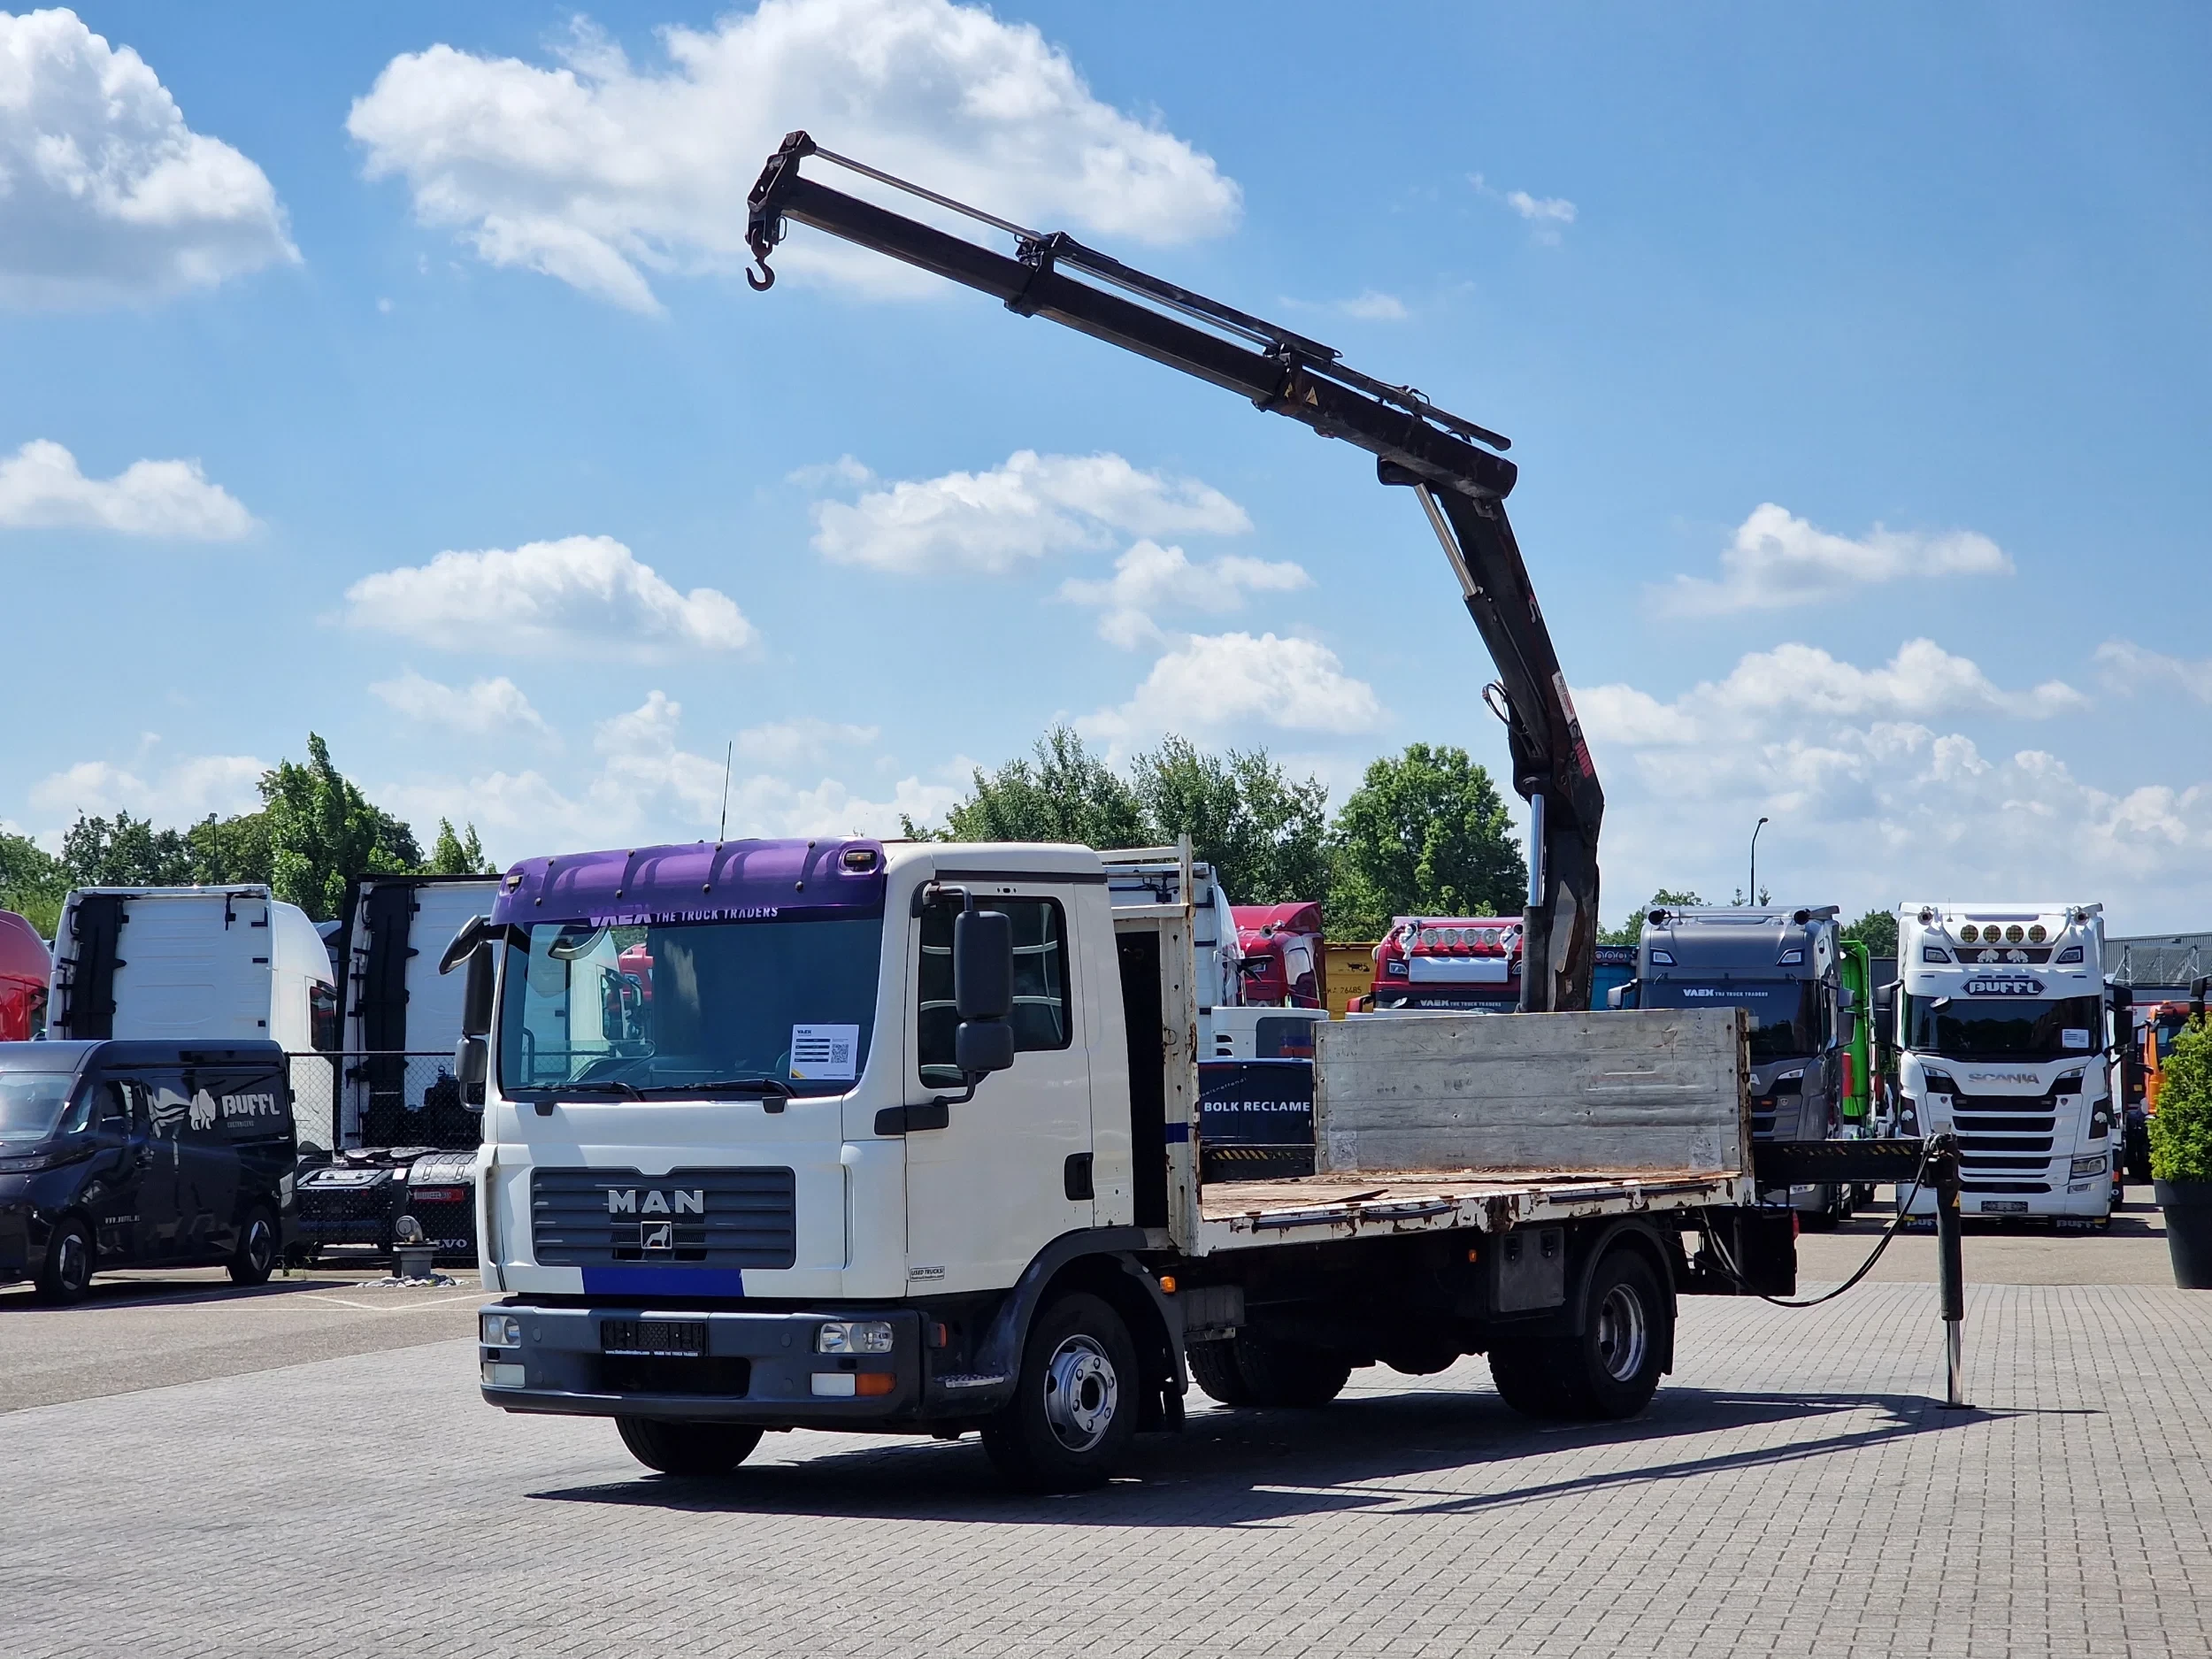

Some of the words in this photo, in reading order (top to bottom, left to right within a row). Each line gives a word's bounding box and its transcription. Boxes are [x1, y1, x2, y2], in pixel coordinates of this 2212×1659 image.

[656, 912, 676, 923] THE
[680, 909, 718, 922] TRUCK
[723, 906, 779, 919] TRADERS
[1683, 988, 1714, 997] VAEX
[1969, 981, 2039, 994] BUFFL
[1968, 1073, 2040, 1085] SCANIA
[222, 1094, 280, 1118] BUFFL
[1204, 1102, 1240, 1112] BOLK
[1243, 1102, 1310, 1112] RECLAME
[608, 1189, 704, 1214] MAN
